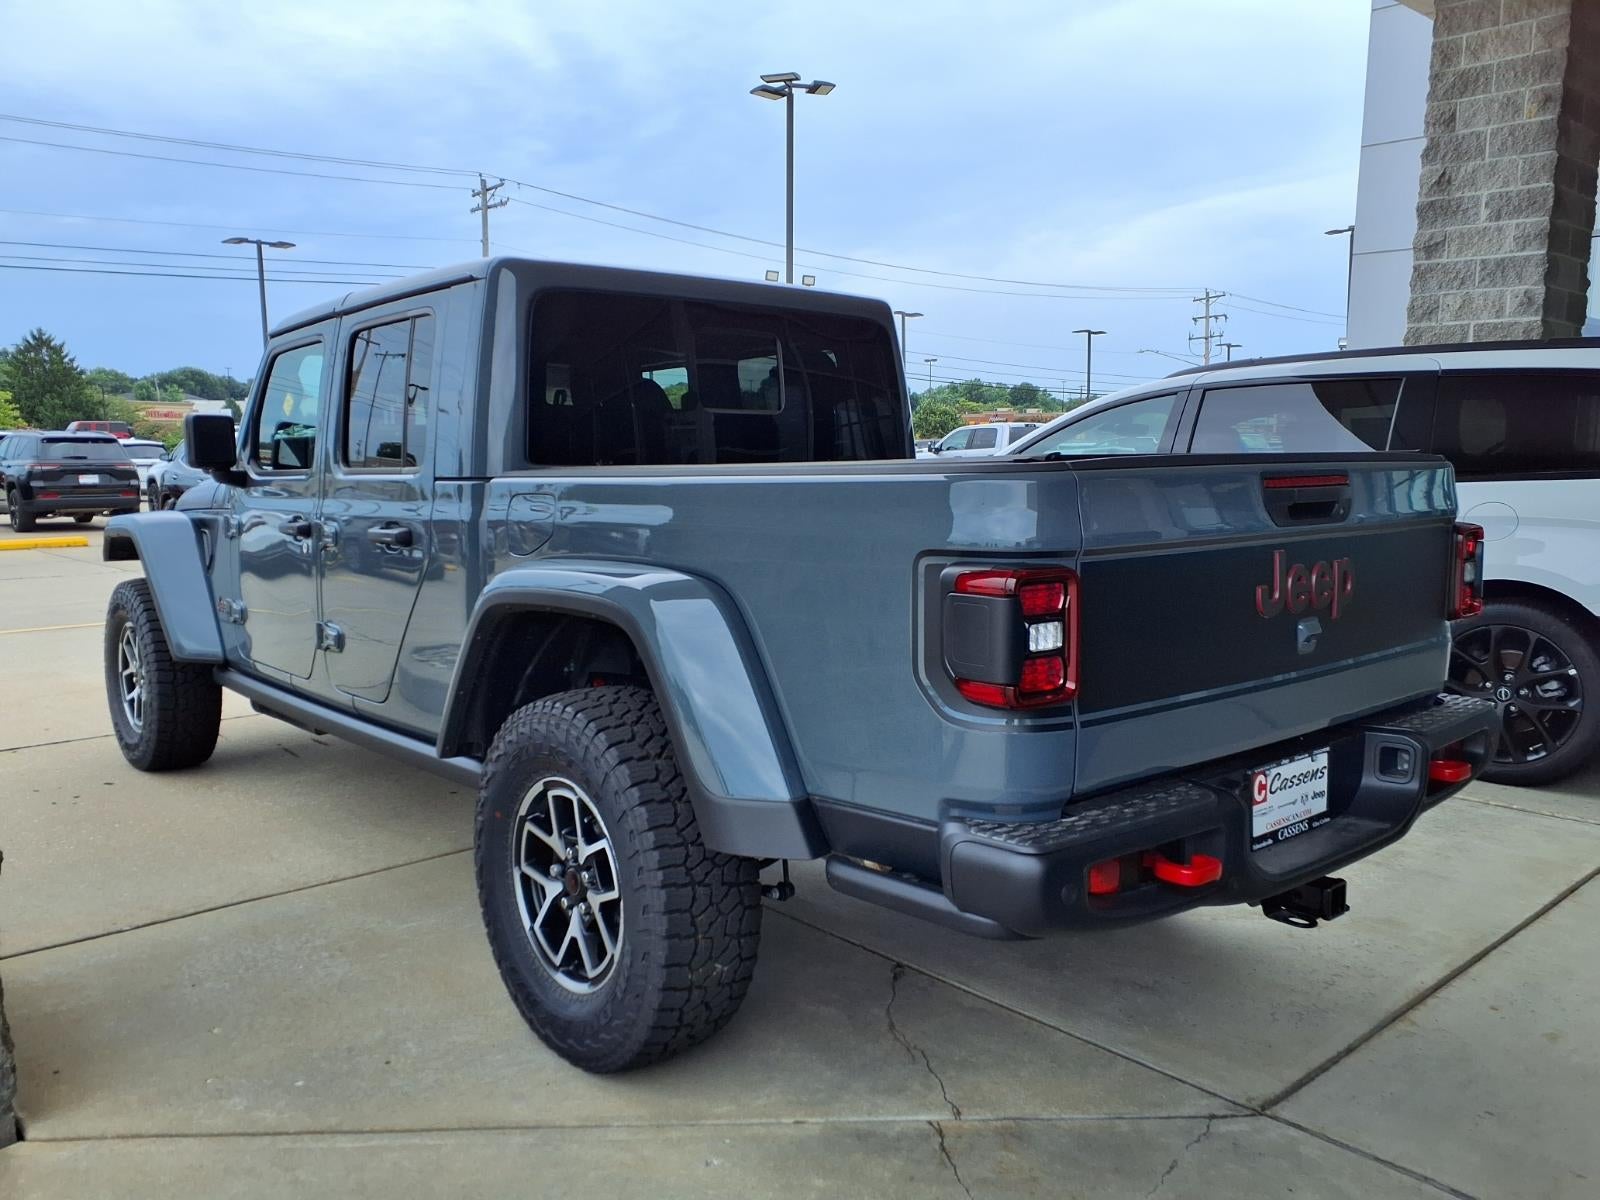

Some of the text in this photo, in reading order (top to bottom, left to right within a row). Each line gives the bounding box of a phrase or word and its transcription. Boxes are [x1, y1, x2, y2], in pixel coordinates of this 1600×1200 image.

[1255, 549, 1353, 621] Jeep
[1268, 766, 1327, 795] Cassens
[1311, 790, 1326, 801] Jeep
[1278, 820, 1309, 841] CASSENS
